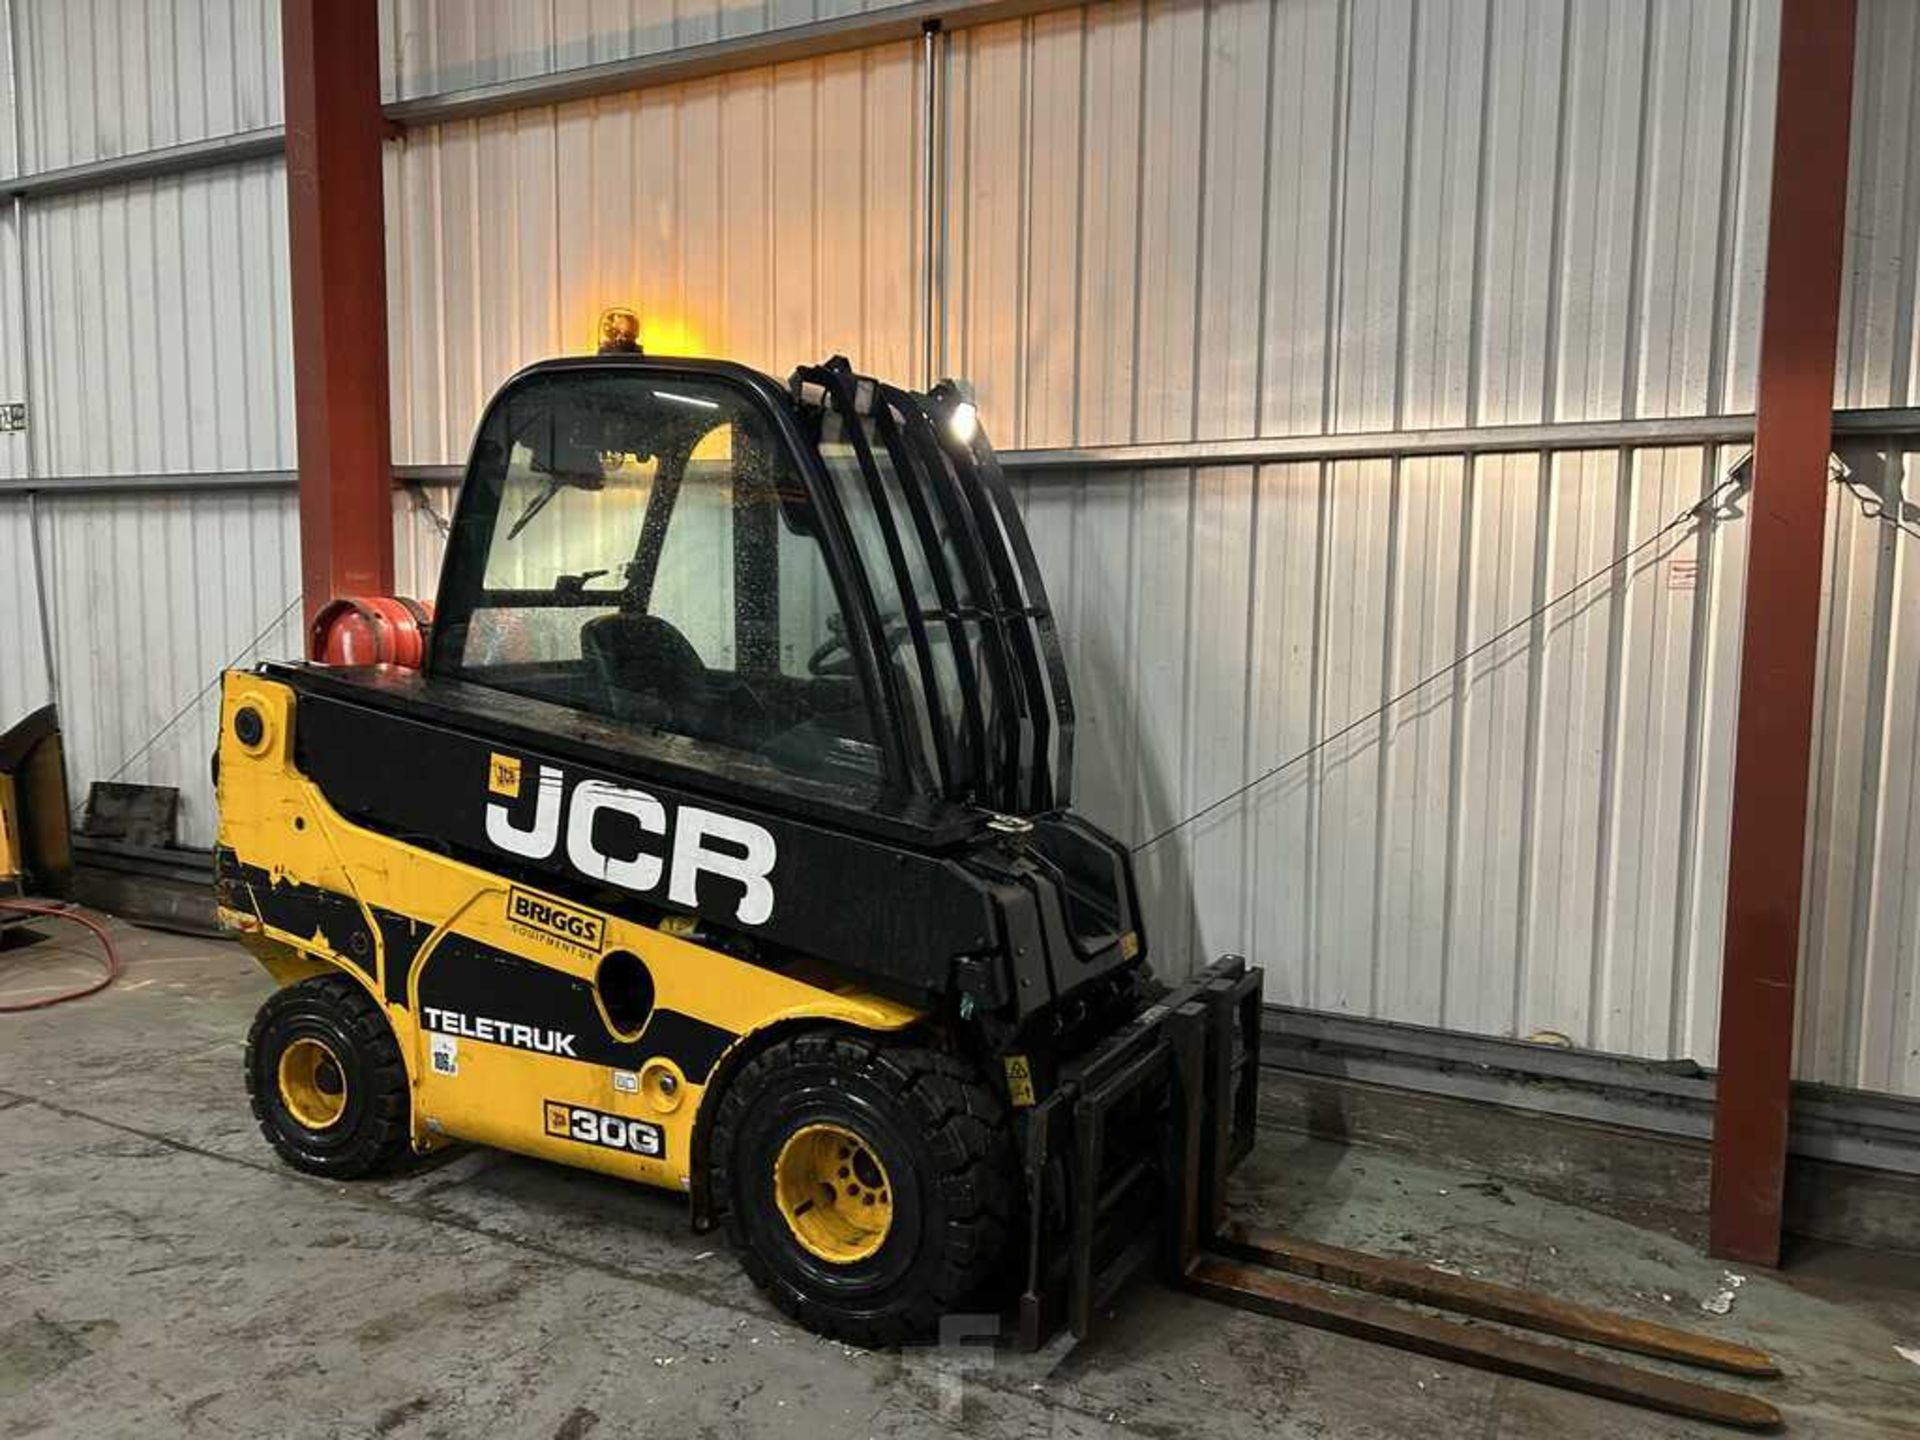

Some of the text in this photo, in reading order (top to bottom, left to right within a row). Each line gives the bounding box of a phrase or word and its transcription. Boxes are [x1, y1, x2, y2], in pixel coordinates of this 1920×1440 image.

[515, 895, 597, 942] BRIGGS
[423, 1006, 577, 1058] TELETRUK
[571, 1109, 660, 1154] 30G
